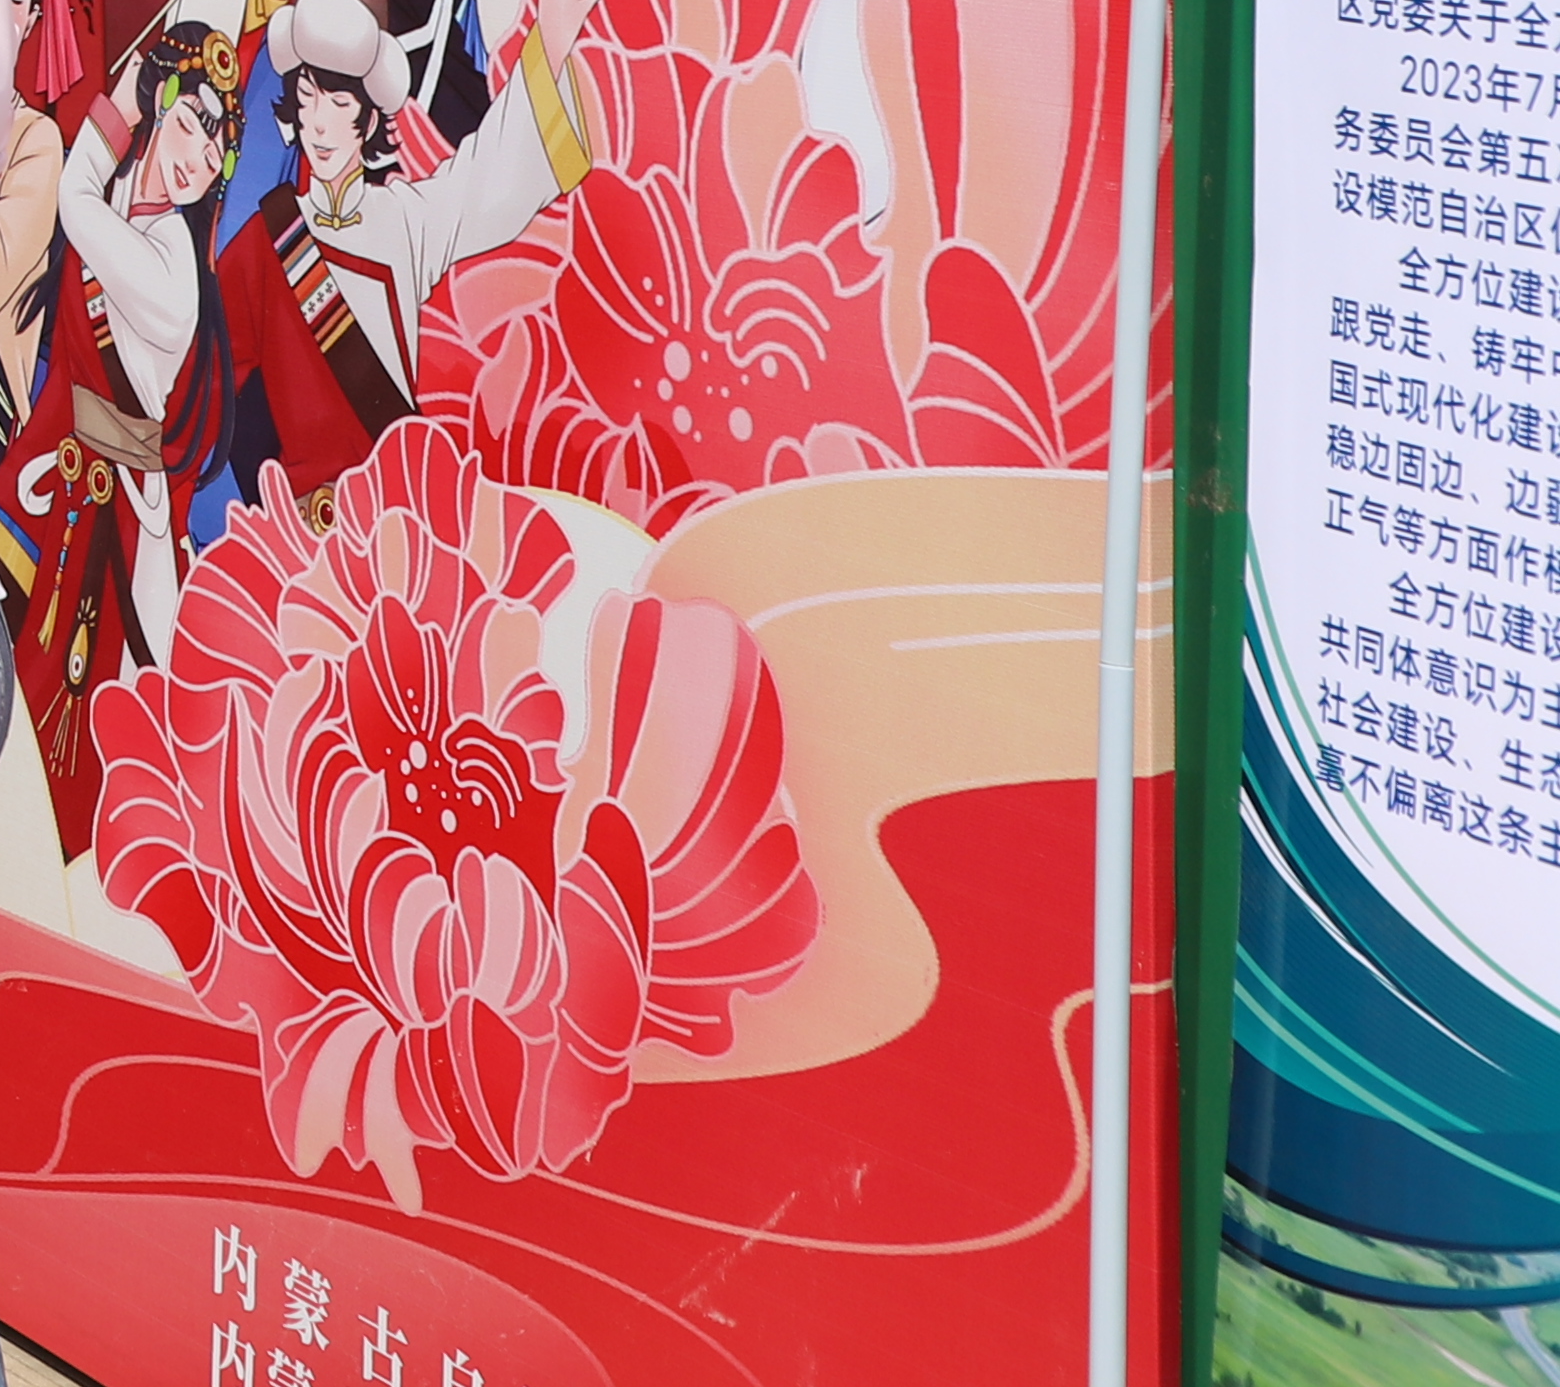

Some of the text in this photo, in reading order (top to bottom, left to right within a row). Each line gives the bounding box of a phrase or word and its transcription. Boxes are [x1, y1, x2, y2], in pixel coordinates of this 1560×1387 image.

[1333, 105, 1560, 185] 务委员会第五
[1333, 169, 1560, 252] 设模范自治区
